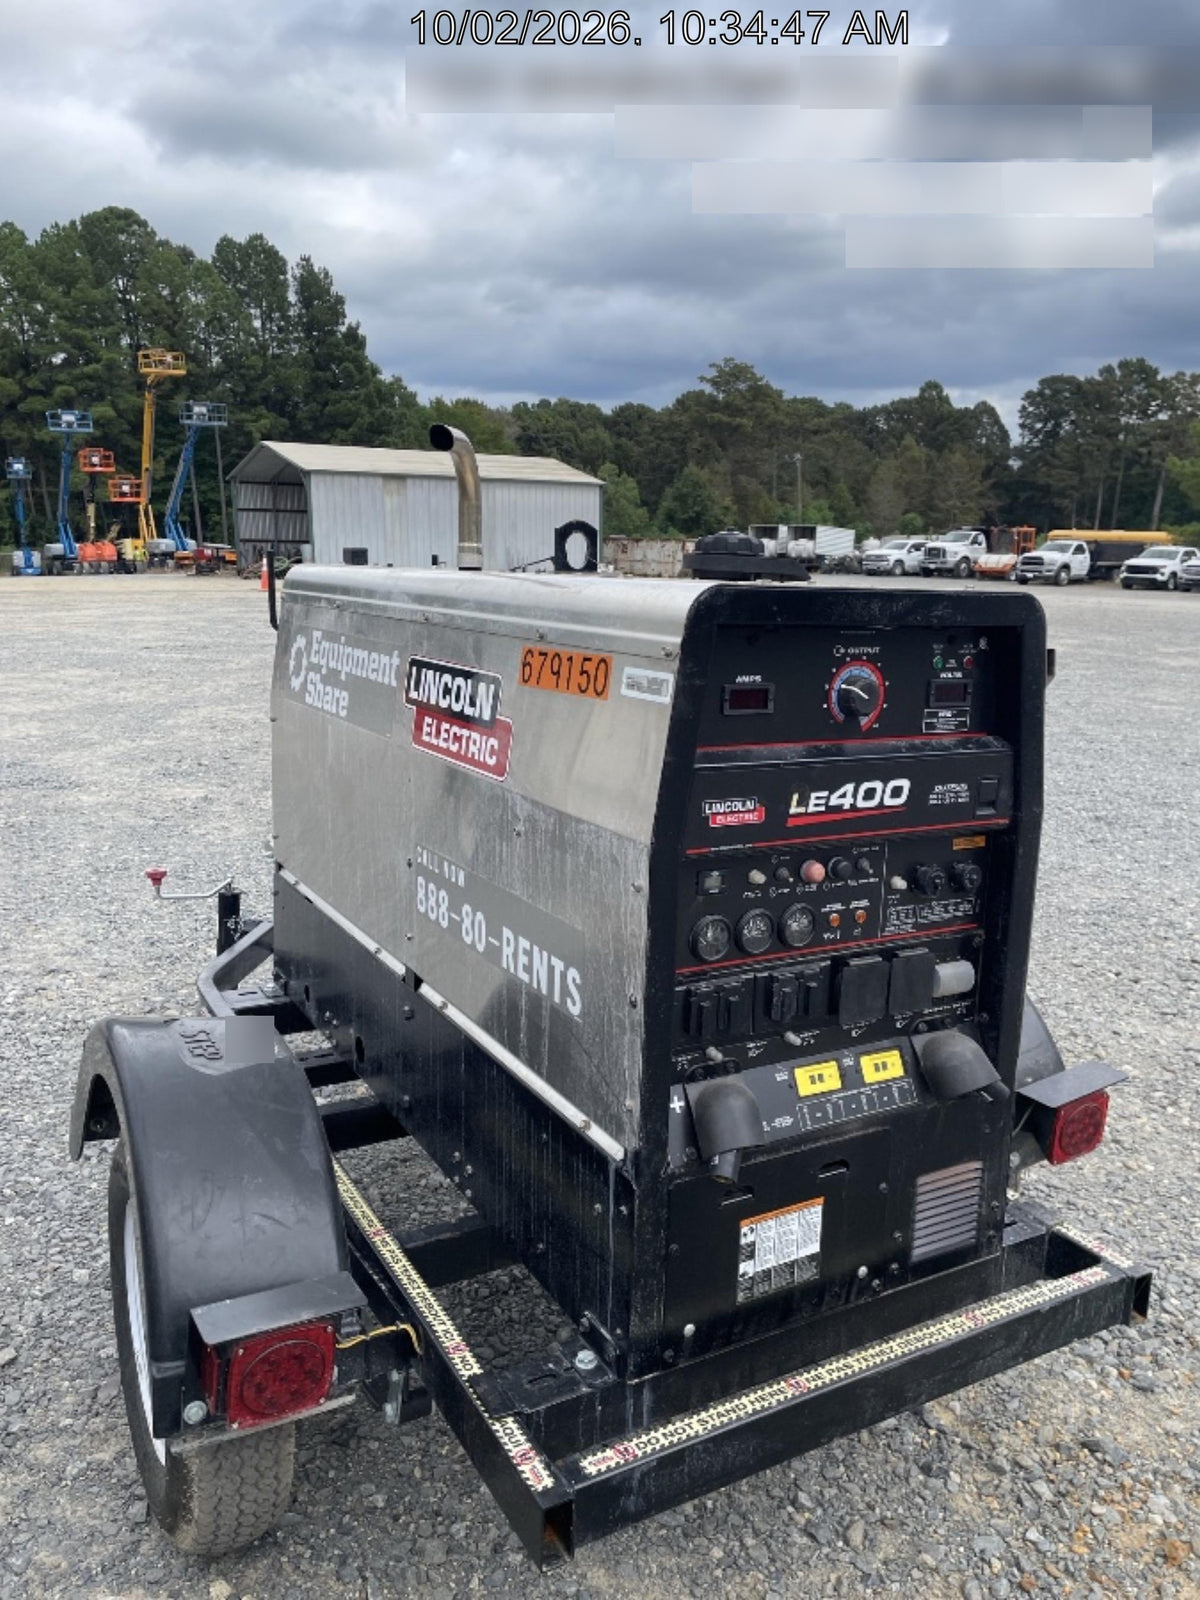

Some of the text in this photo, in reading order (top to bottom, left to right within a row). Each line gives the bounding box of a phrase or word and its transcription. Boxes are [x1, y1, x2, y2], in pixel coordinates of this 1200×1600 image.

[308, 629, 400, 689] Equipment
[521, 647, 609, 698] 679150
[735, 674, 763, 684] AMPS
[304, 671, 350, 719] Share
[409, 665, 496, 722] LINCOLN
[421, 717, 500, 768] ELECTRIC
[704, 799, 755, 815] LINCOLN
[789, 778, 911, 815] LE400
[416, 875, 582, 1017] 888-80-RENTS
[826, 1361, 855, 1378] PAS
[855, 1345, 896, 1366] TENEZ
[897, 1326, 950, 1351] DEBOUT
[634, 1385, 786, 1452] DO NOT STAND HERE
